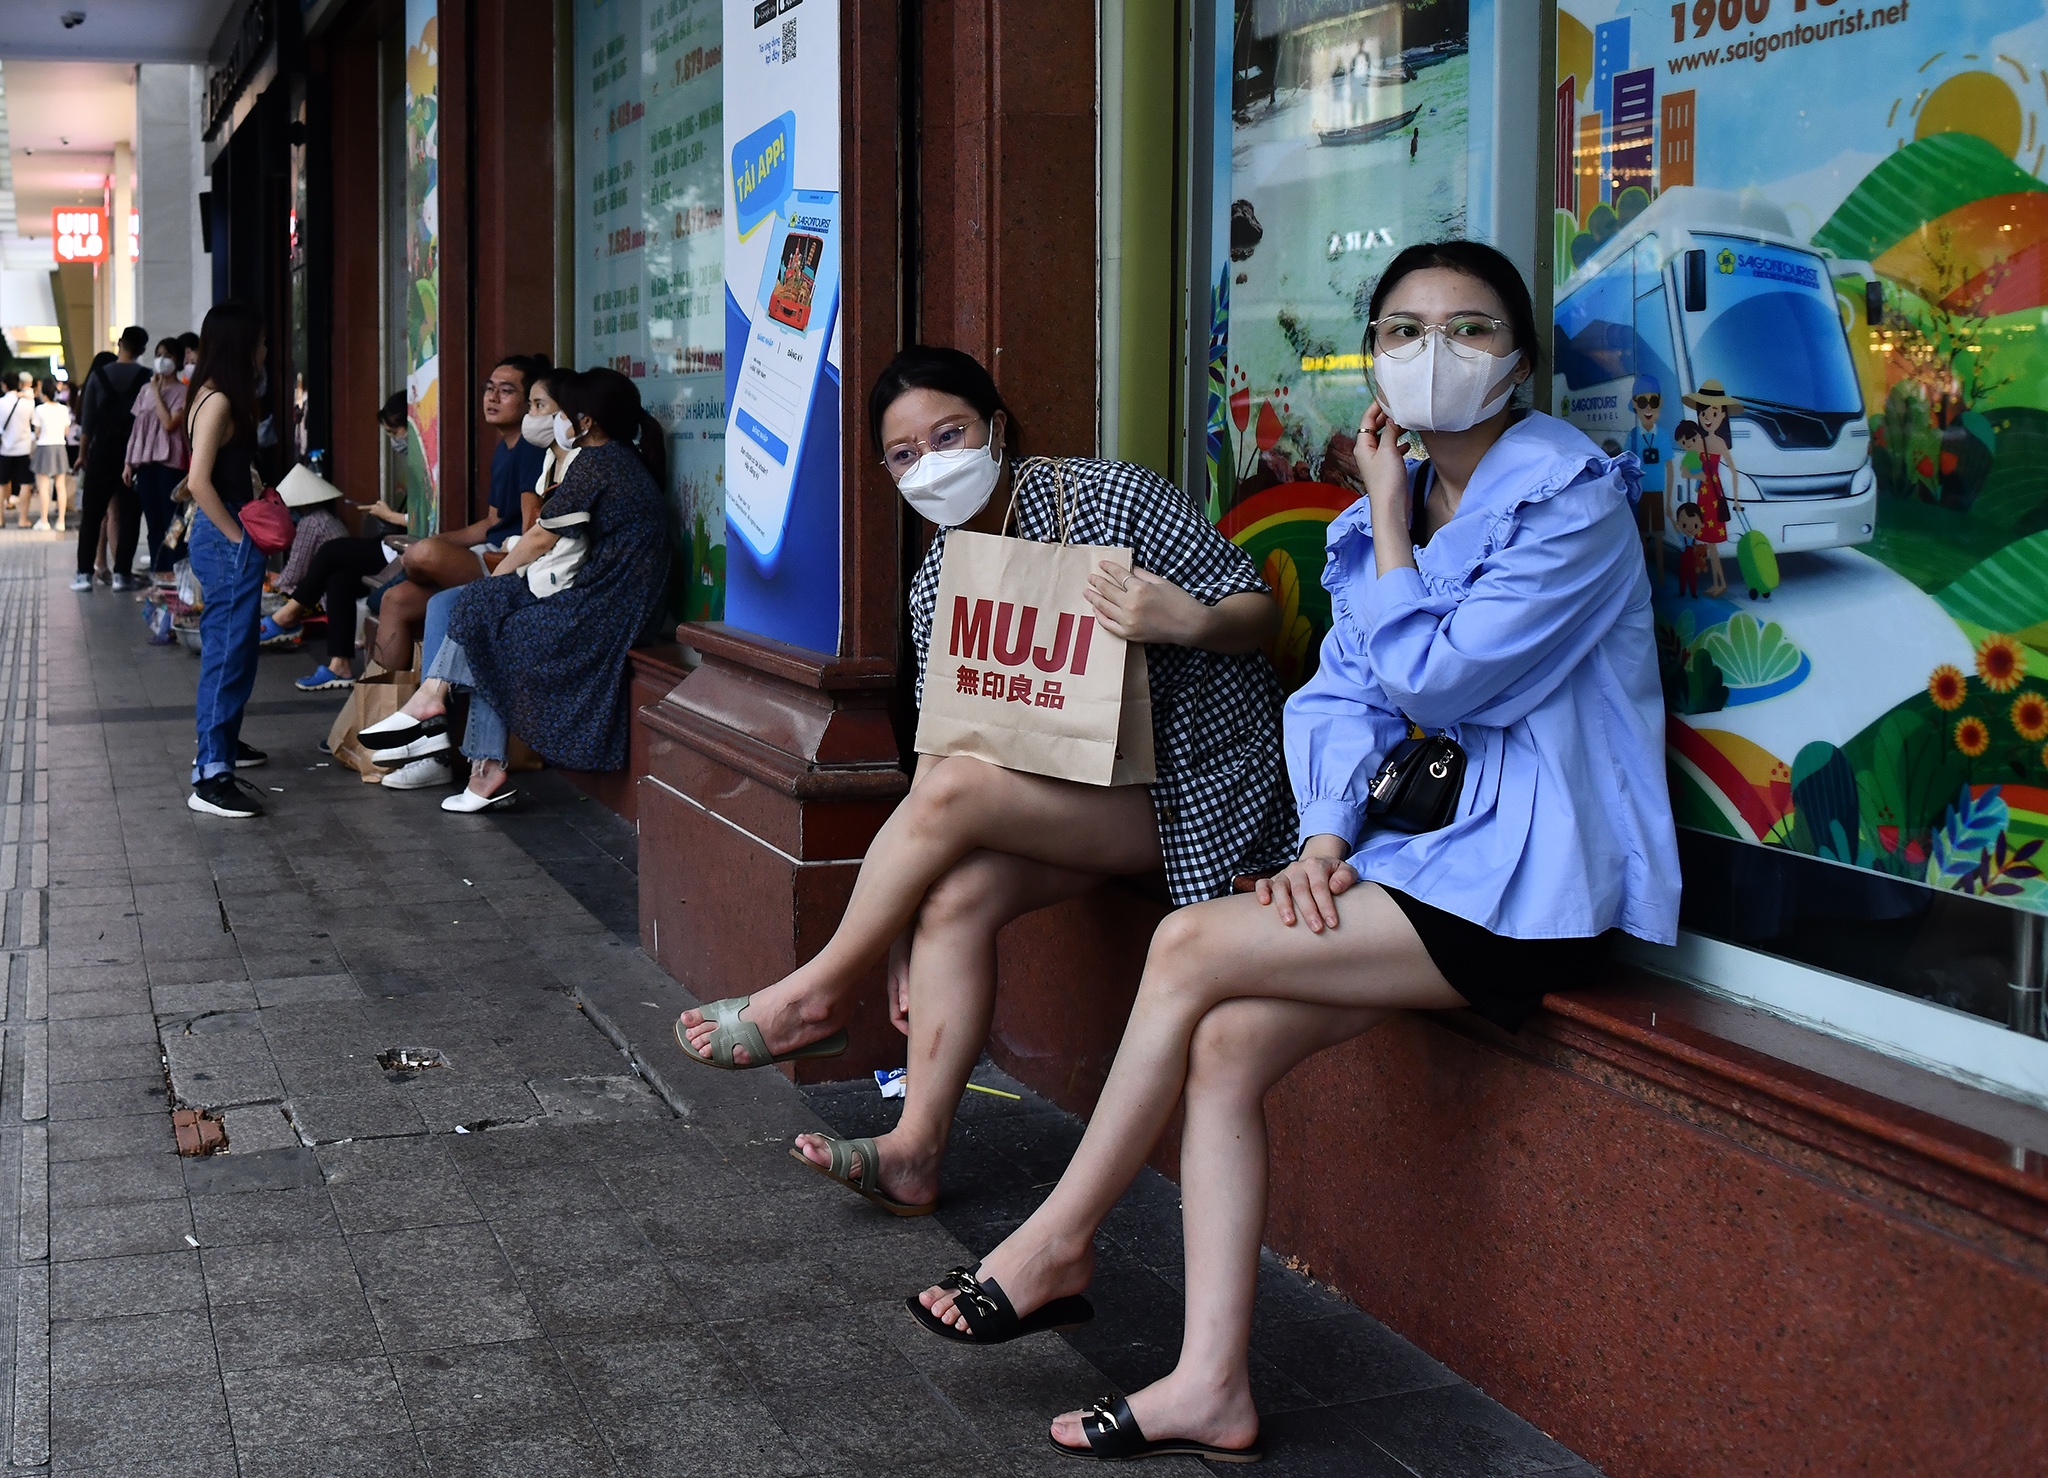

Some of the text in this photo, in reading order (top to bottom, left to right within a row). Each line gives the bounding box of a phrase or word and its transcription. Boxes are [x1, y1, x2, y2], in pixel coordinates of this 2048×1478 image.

[1667, 2, 1909, 75] www.saigontourist.net
[1671, 0, 1770, 44] 1900
[737, 159, 757, 203] TẢI
[757, 132, 786, 185] APP!
[57, 213, 98, 235] UNI
[58, 234, 103, 260] QLO
[1587, 412, 1618, 422] TRAVEL
[949, 596, 1095, 676] MUJI
[956, 665, 1065, 710] 無印良品
